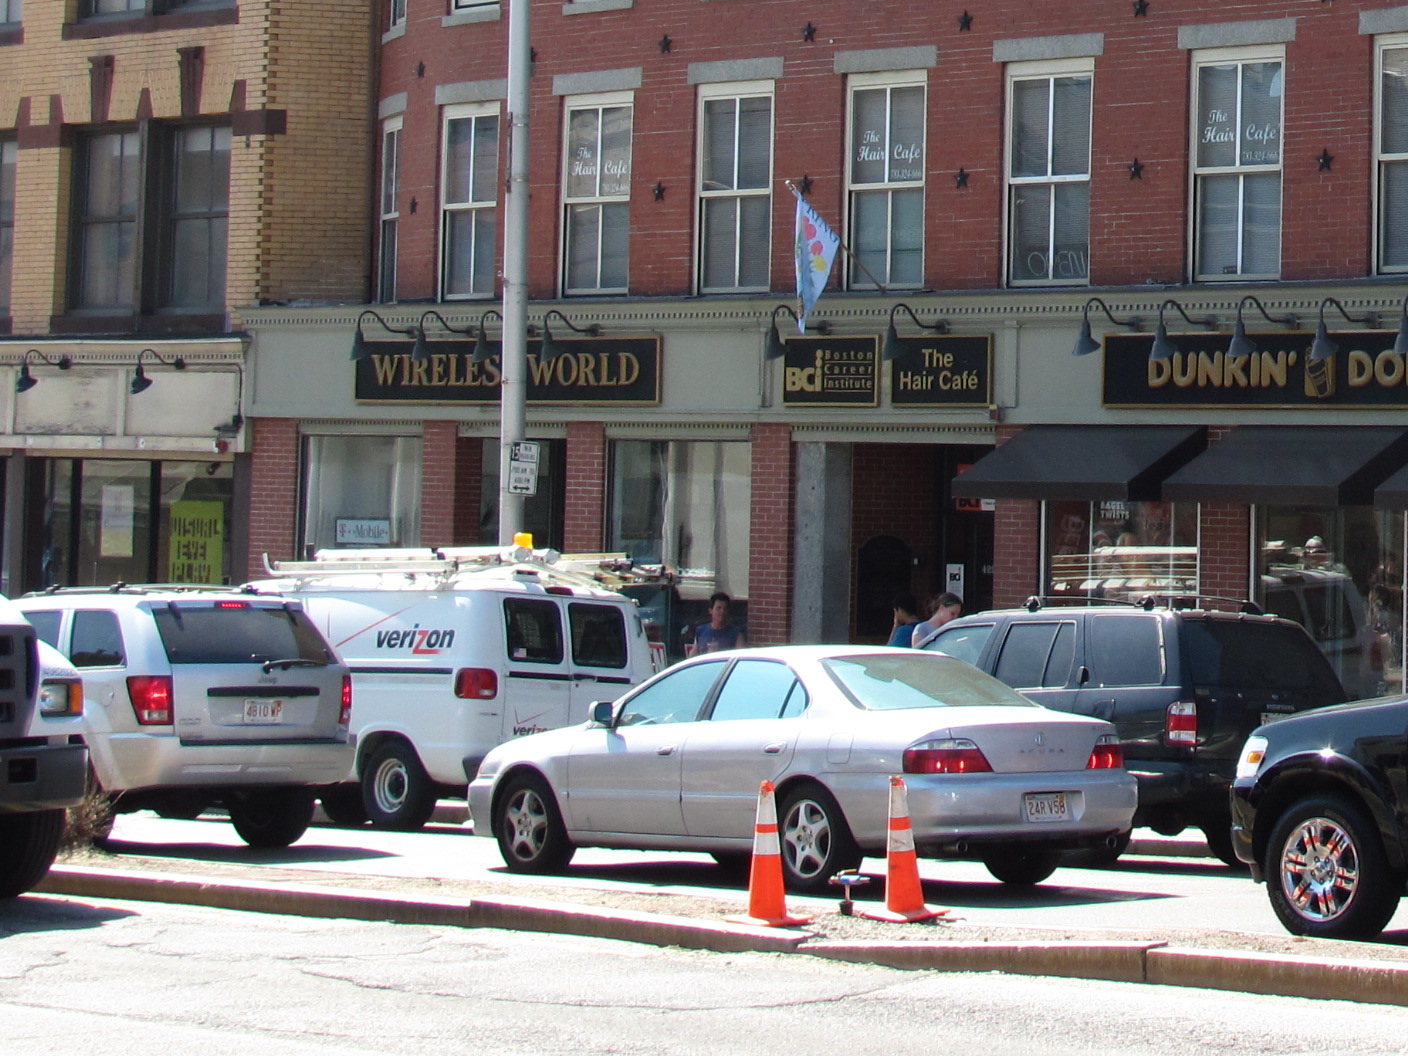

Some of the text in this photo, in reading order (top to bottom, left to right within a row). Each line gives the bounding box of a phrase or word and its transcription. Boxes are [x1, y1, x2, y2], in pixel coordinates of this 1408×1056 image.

[1208, 109, 1228, 124] The
[863, 130, 880, 144] The
[1202, 126, 1235, 144] Hair
[576, 147, 593, 160] The
[857, 145, 886, 162] Hair
[571, 161, 596, 176] Hair
[824, 349, 874, 361] Boston
[921, 348, 954, 369] The
[371, 352, 502, 387] WIRELES
[526, 352, 640, 387] WORLD
[824, 363, 874, 375] Career
[1147, 348, 1298, 388] DUNKIN'
[823, 377, 874, 390] Institute
[899, 368, 979, 391] Hair Café
[1100, 510, 1130, 520] TWISTS
[377, 624, 455, 655] verizon
[246, 705, 270, 717] 4810
[513, 724, 556, 736] veriz
[1028, 800, 1066, 816] 24R V58
